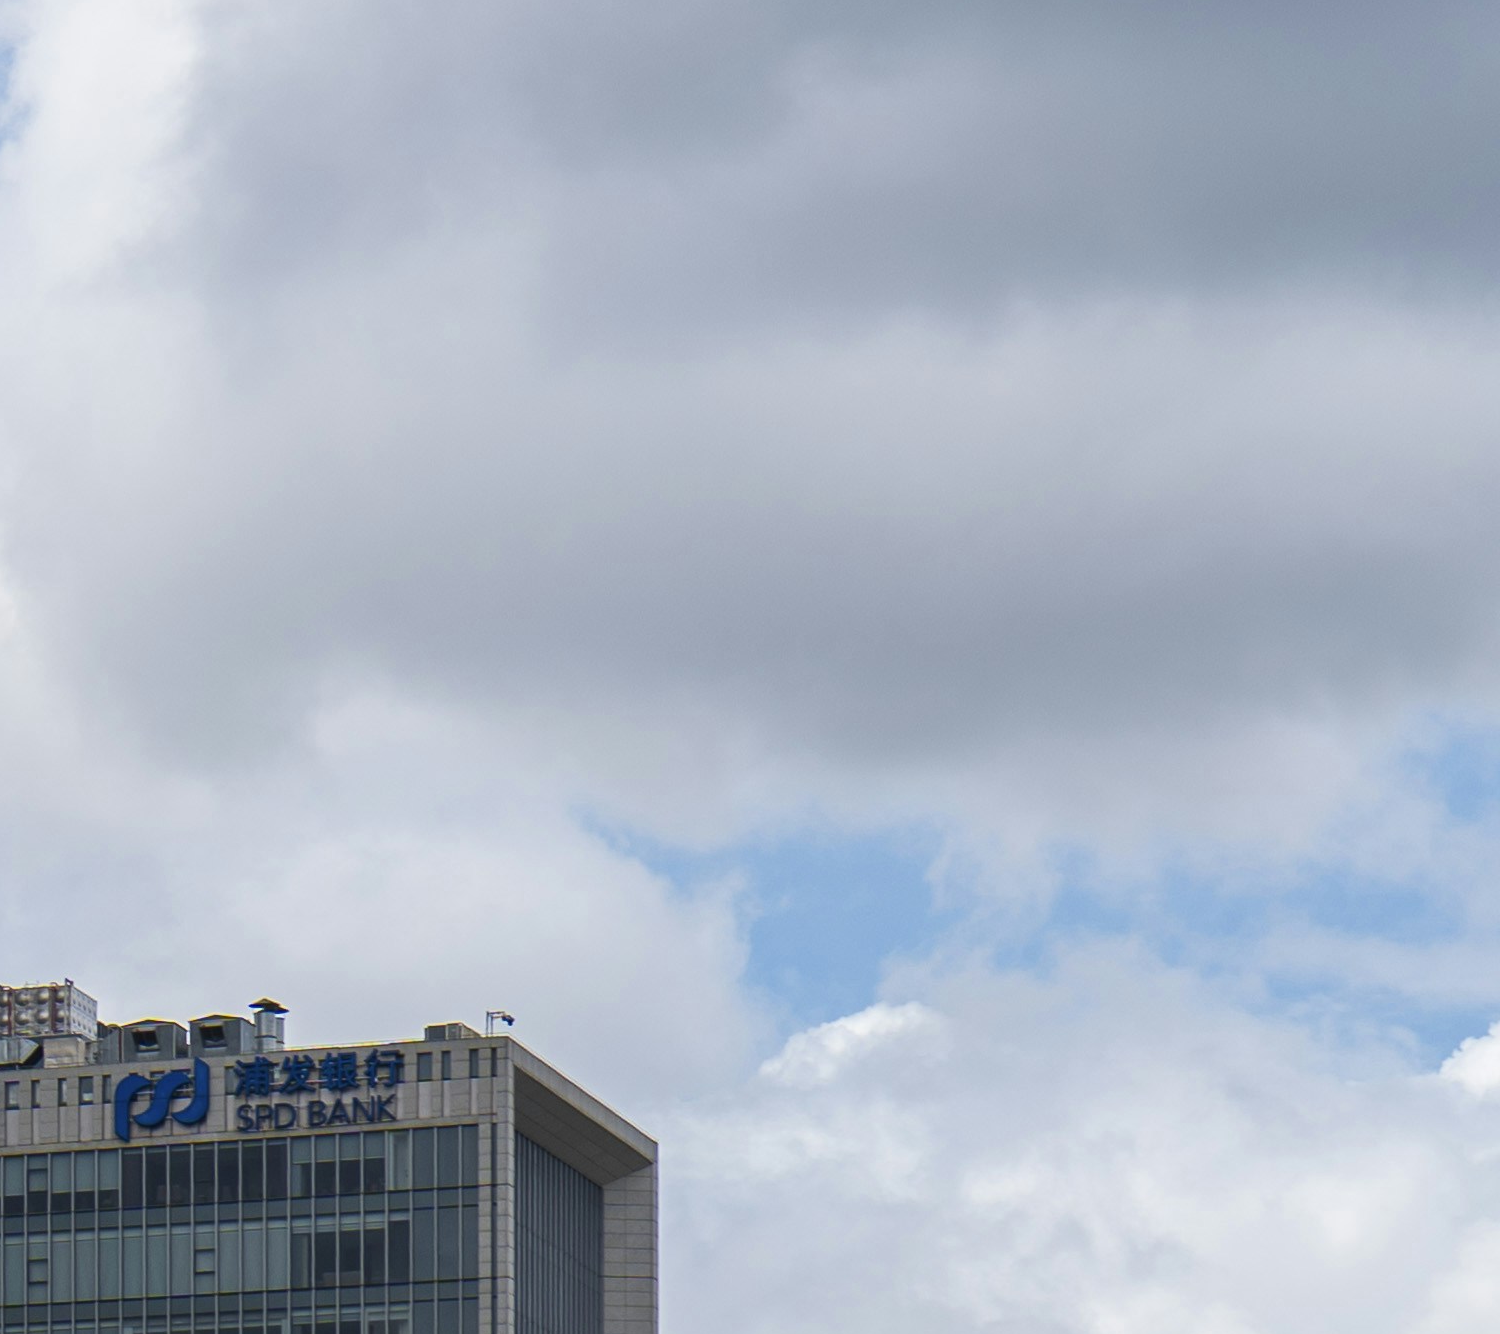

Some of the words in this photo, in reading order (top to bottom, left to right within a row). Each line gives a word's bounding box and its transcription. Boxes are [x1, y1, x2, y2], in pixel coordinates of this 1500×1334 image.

[233, 1049, 404, 1097] 浦发银行
[237, 1102, 297, 1132] SPD
[308, 1094, 397, 1127] BANK
